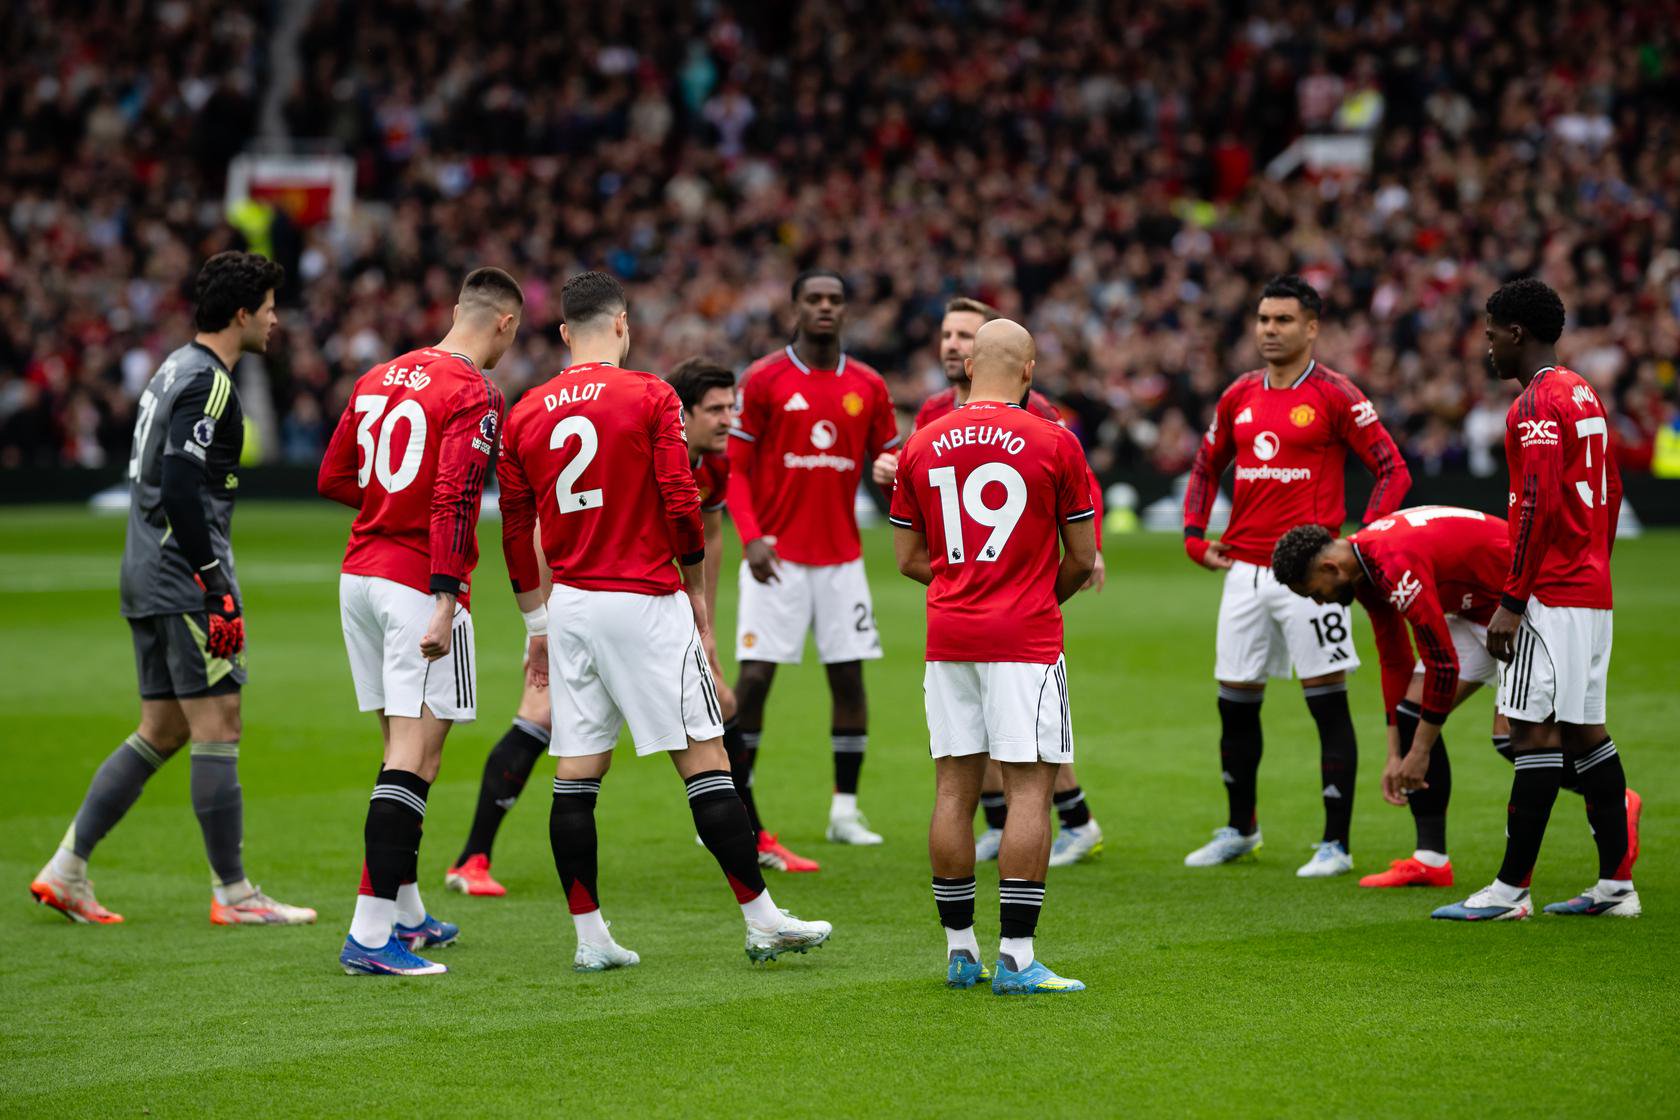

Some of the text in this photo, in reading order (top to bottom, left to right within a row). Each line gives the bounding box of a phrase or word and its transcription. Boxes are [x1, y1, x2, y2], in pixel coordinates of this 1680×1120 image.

[543, 383, 606, 412] DALOT
[355, 394, 427, 494] 30
[931, 426, 1026, 457] MBEUMO
[1517, 420, 1558, 441] DXC
[549, 415, 604, 515] 2
[928, 462, 1028, 565] 19
[1309, 612, 1347, 647] 18
